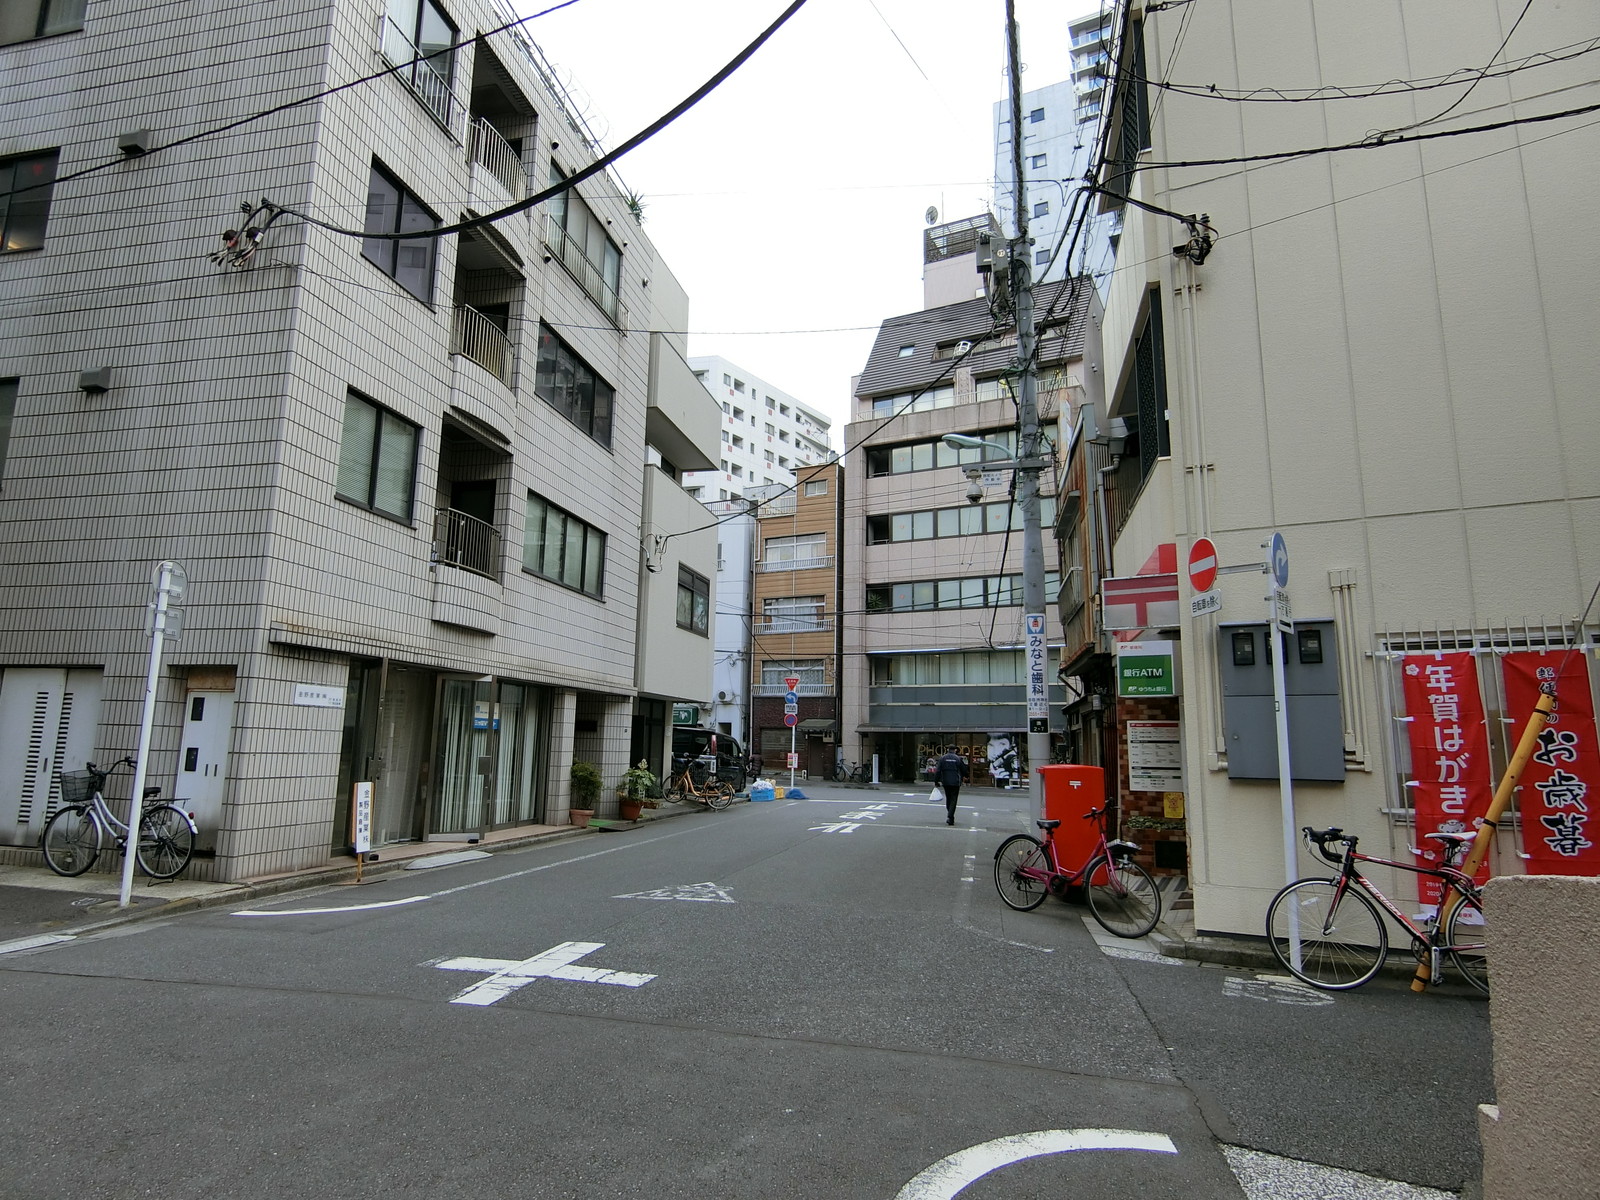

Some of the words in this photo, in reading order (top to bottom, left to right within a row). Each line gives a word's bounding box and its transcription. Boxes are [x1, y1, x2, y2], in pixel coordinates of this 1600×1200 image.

[1030, 636, 1044, 696] みなと歯科
[1123, 668, 1163, 677] 銀行ATM
[1535, 666, 1559, 724] 郵便の
[1425, 664, 1470, 814] 年賀はがき
[808, 804, 899, 834] 止まれ
[1533, 727, 1592, 856] お歳暮
